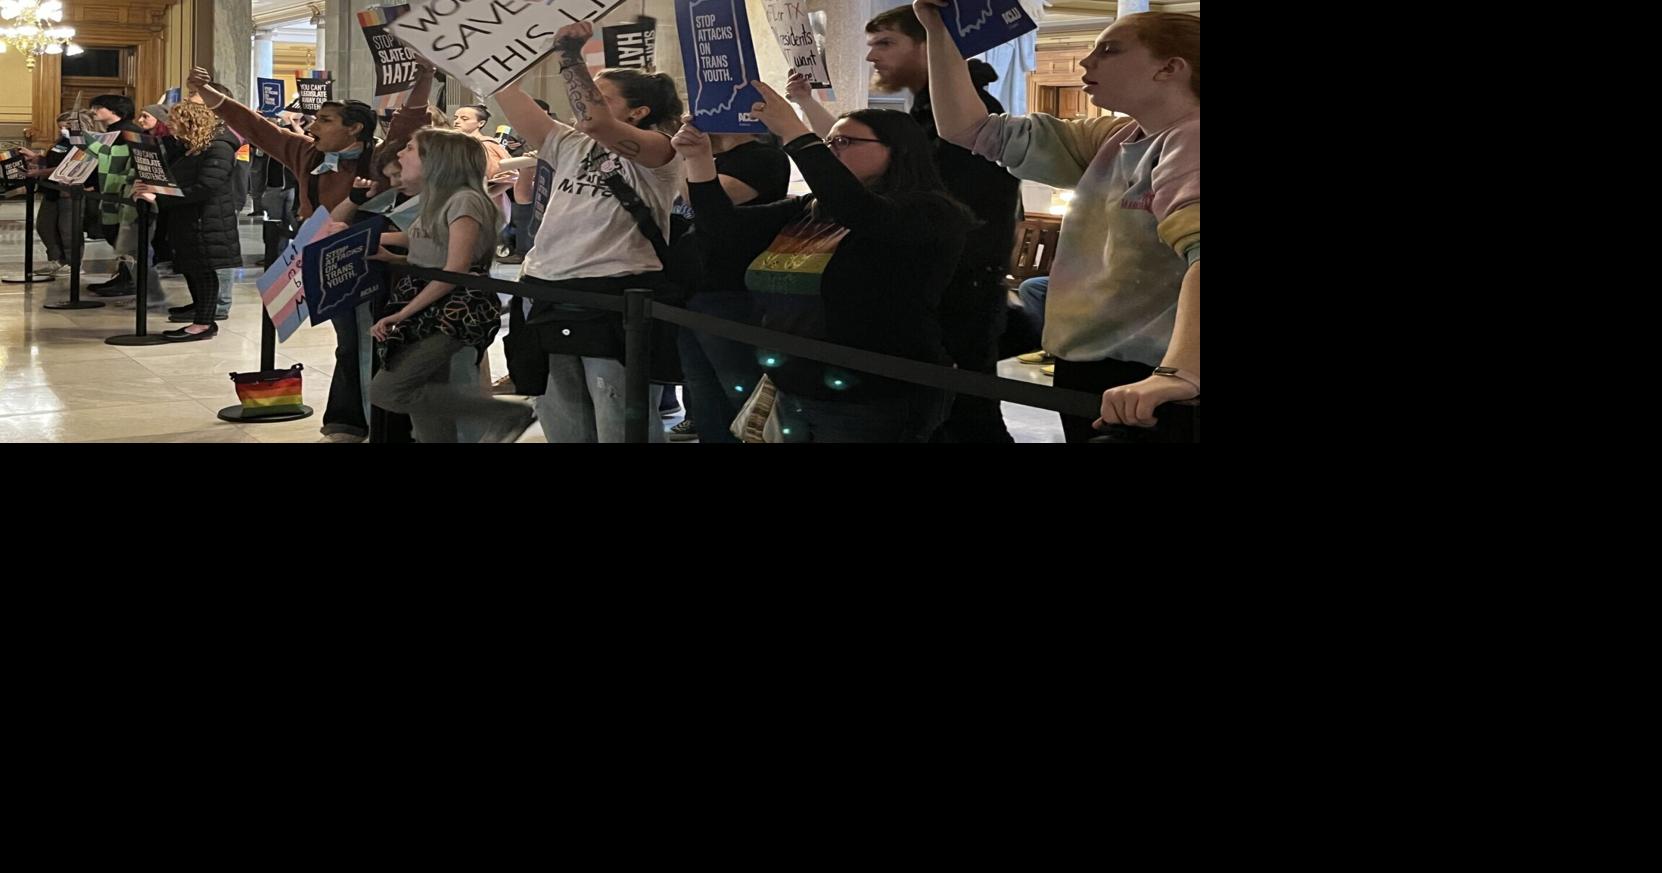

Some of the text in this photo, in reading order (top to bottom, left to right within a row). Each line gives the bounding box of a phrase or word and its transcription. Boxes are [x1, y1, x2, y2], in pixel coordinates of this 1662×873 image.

[695, 14, 716, 28] STOP
[373, 33, 394, 49] STOP
[698, 26, 733, 42] ATTACKS
[378, 47, 406, 63] SLATE
[465, 24, 554, 82] THIS
[616, 32, 646, 67] HAT
[699, 42, 711, 55] ON
[701, 55, 728, 69] TRANS
[382, 60, 419, 86] HATE
[703, 69, 733, 82] YOUTH.
[325, 245, 349, 258] STOP
[325, 245, 364, 266] ATTACKS
[325, 263, 338, 273] ON
[326, 262, 354, 280] TRANS
